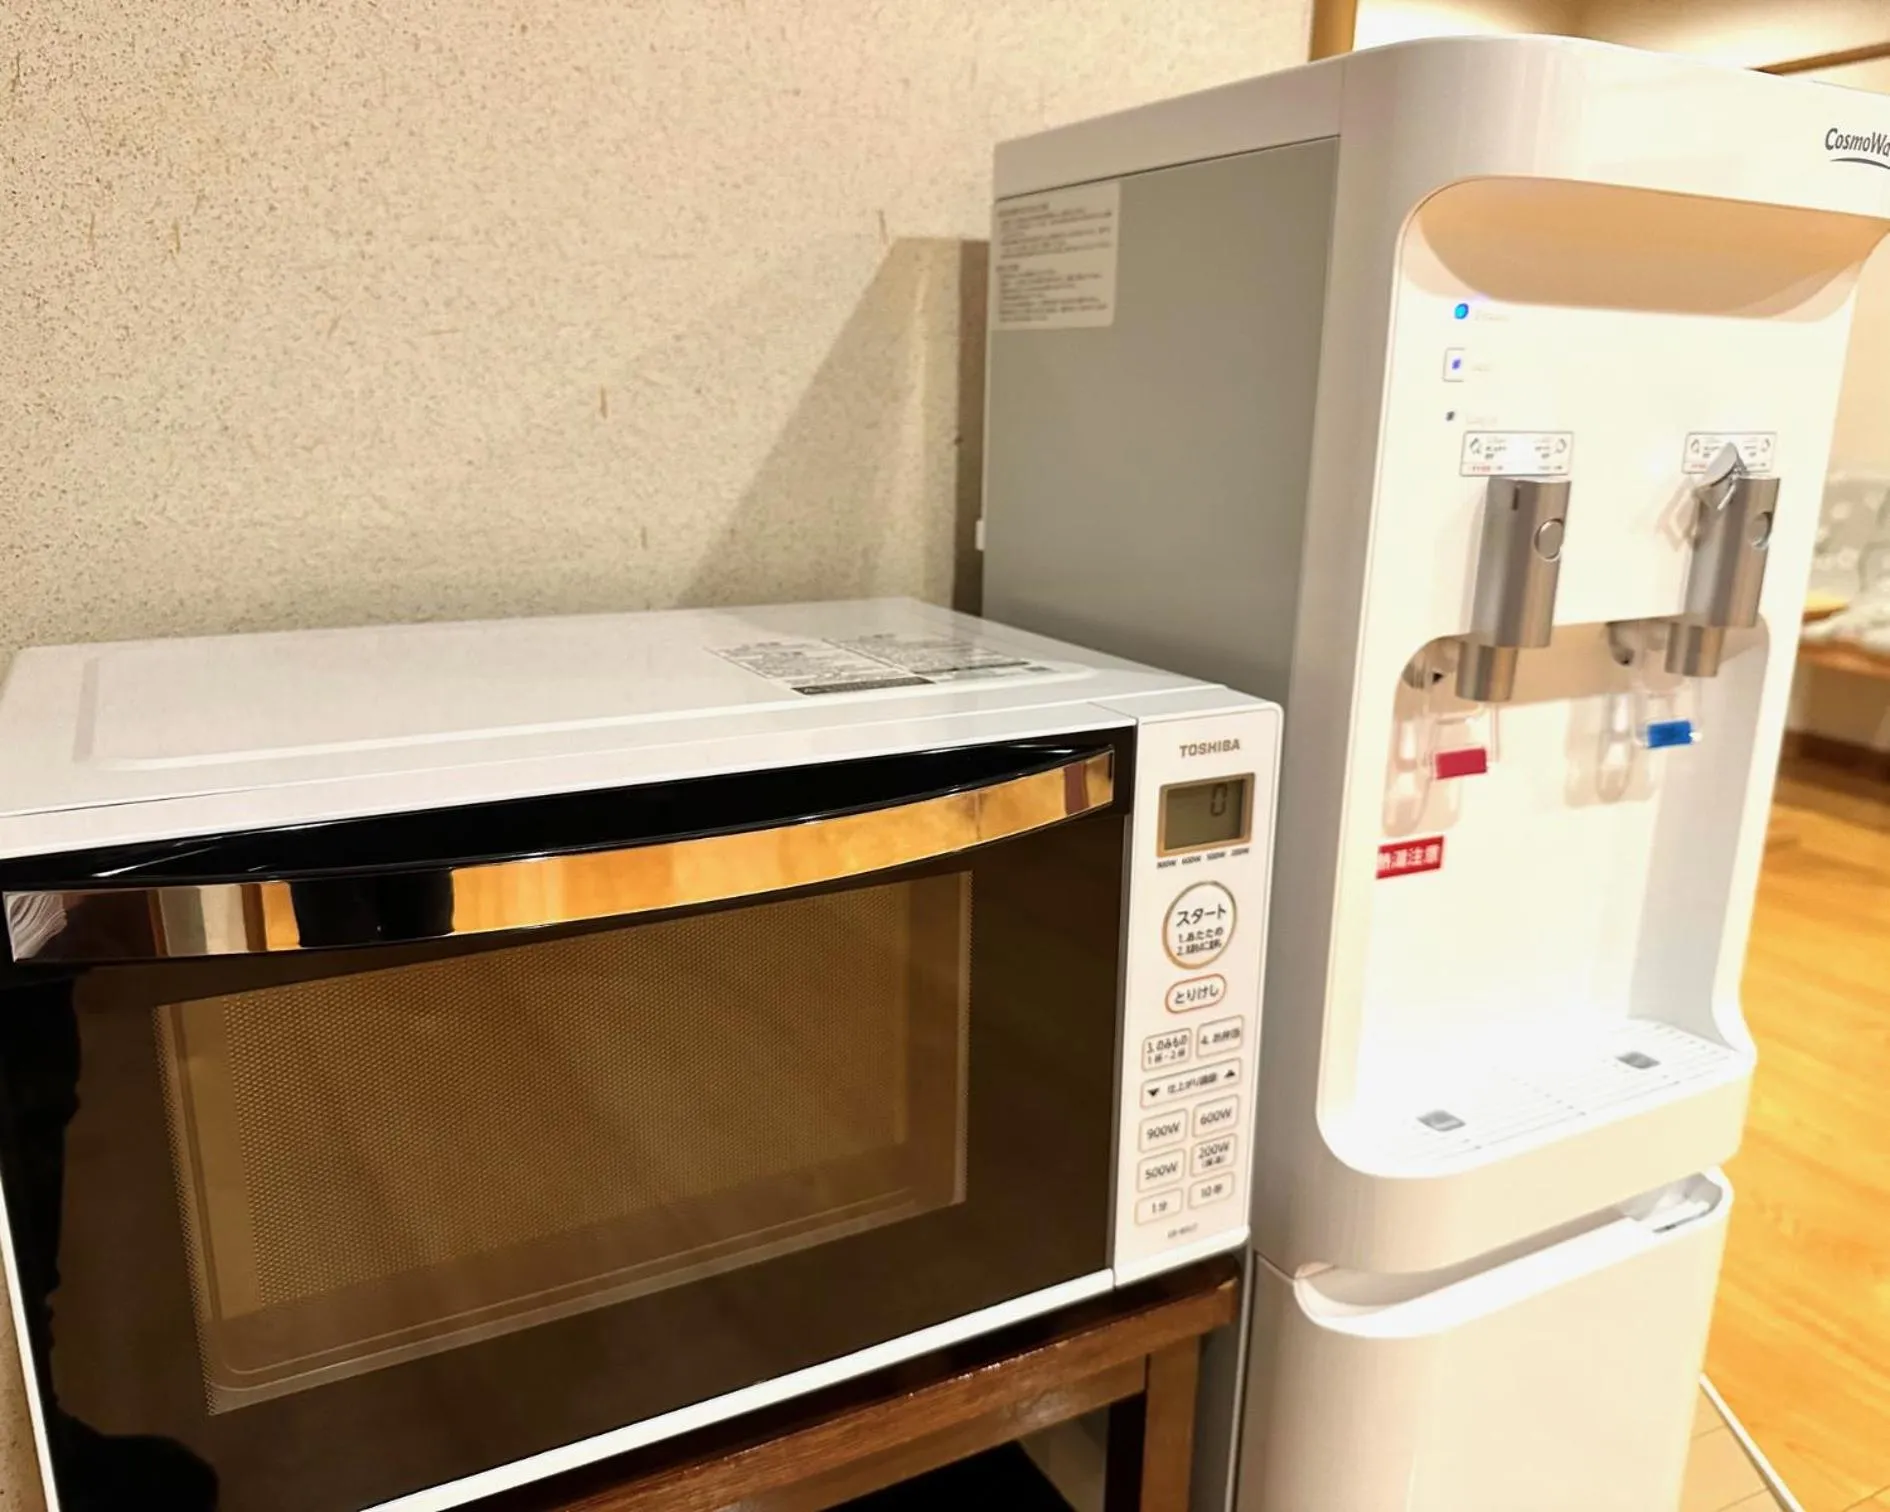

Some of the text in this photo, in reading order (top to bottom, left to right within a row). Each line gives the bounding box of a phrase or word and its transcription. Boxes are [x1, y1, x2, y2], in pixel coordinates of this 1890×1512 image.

[1179, 738, 1241, 758] TOSHIBA
[1176, 903, 1227, 928] スタート
[1173, 981, 1220, 1005] とりけし
[1199, 1107, 1233, 1126] 600W
[1146, 1121, 1181, 1140] 900W
[1197, 1141, 1230, 1160] 200W
[1144, 1161, 1179, 1180] 500W
